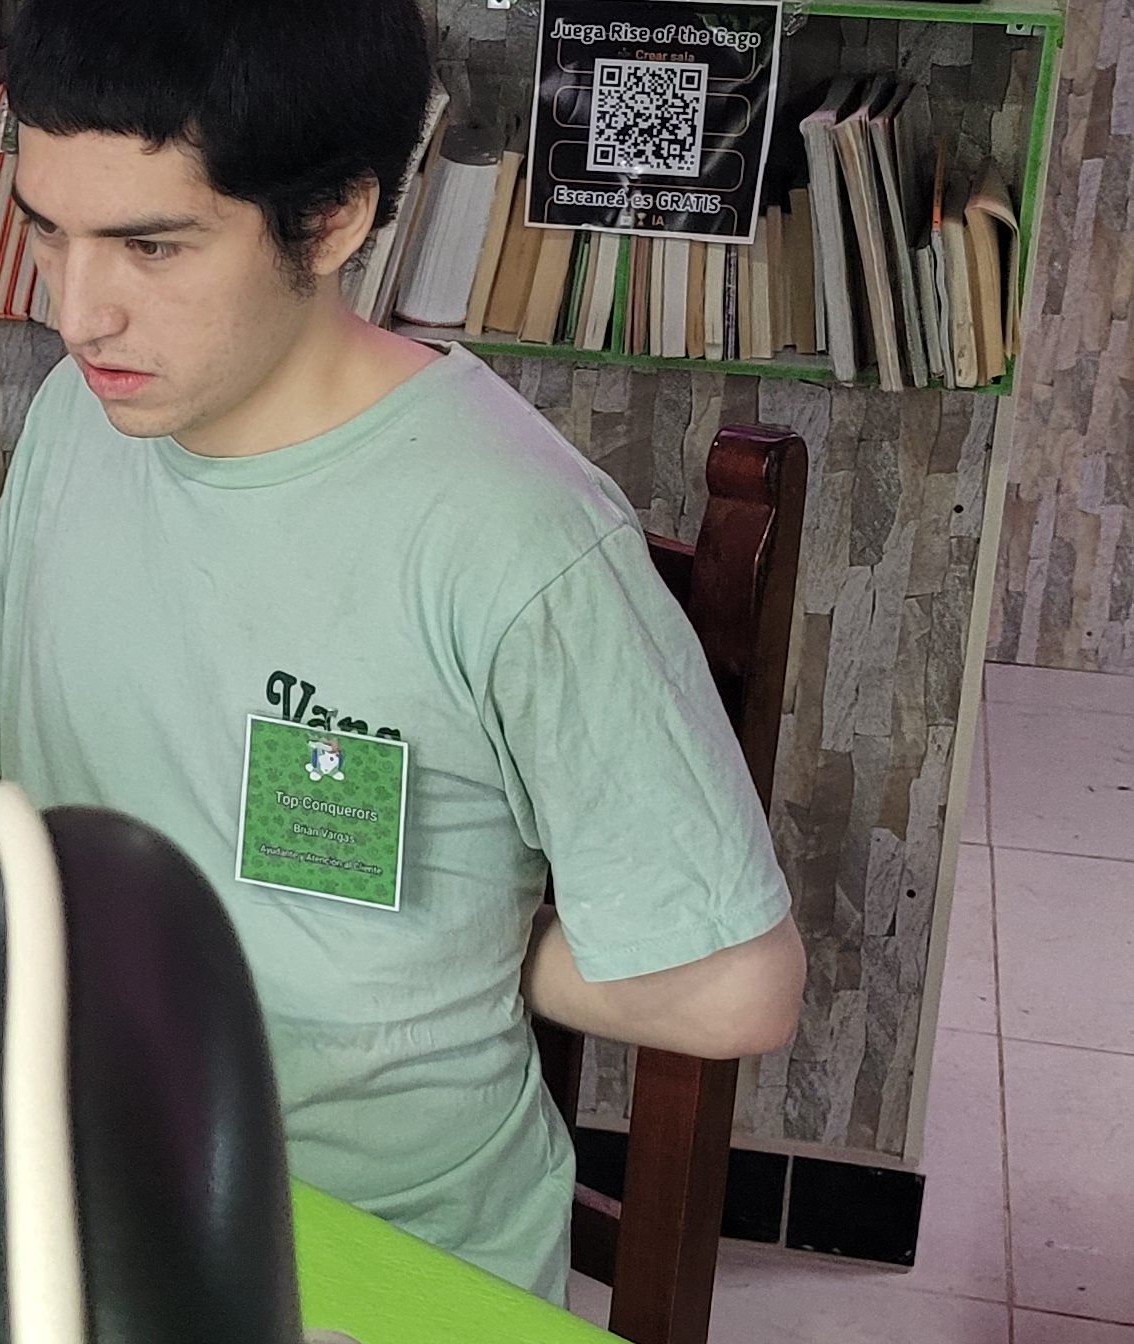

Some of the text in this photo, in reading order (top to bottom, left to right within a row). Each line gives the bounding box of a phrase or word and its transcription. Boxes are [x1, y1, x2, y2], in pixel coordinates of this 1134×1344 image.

[550, 18, 761, 52] Juega Rise of the Gago
[635, 48, 696, 62] Crear sala
[553, 185, 721, 214] Escaneá es GRATIS
[651, 213, 665, 227] IA
[293, 823, 356, 845] Brian Vargas
[305, 852, 344, 868] Atención
